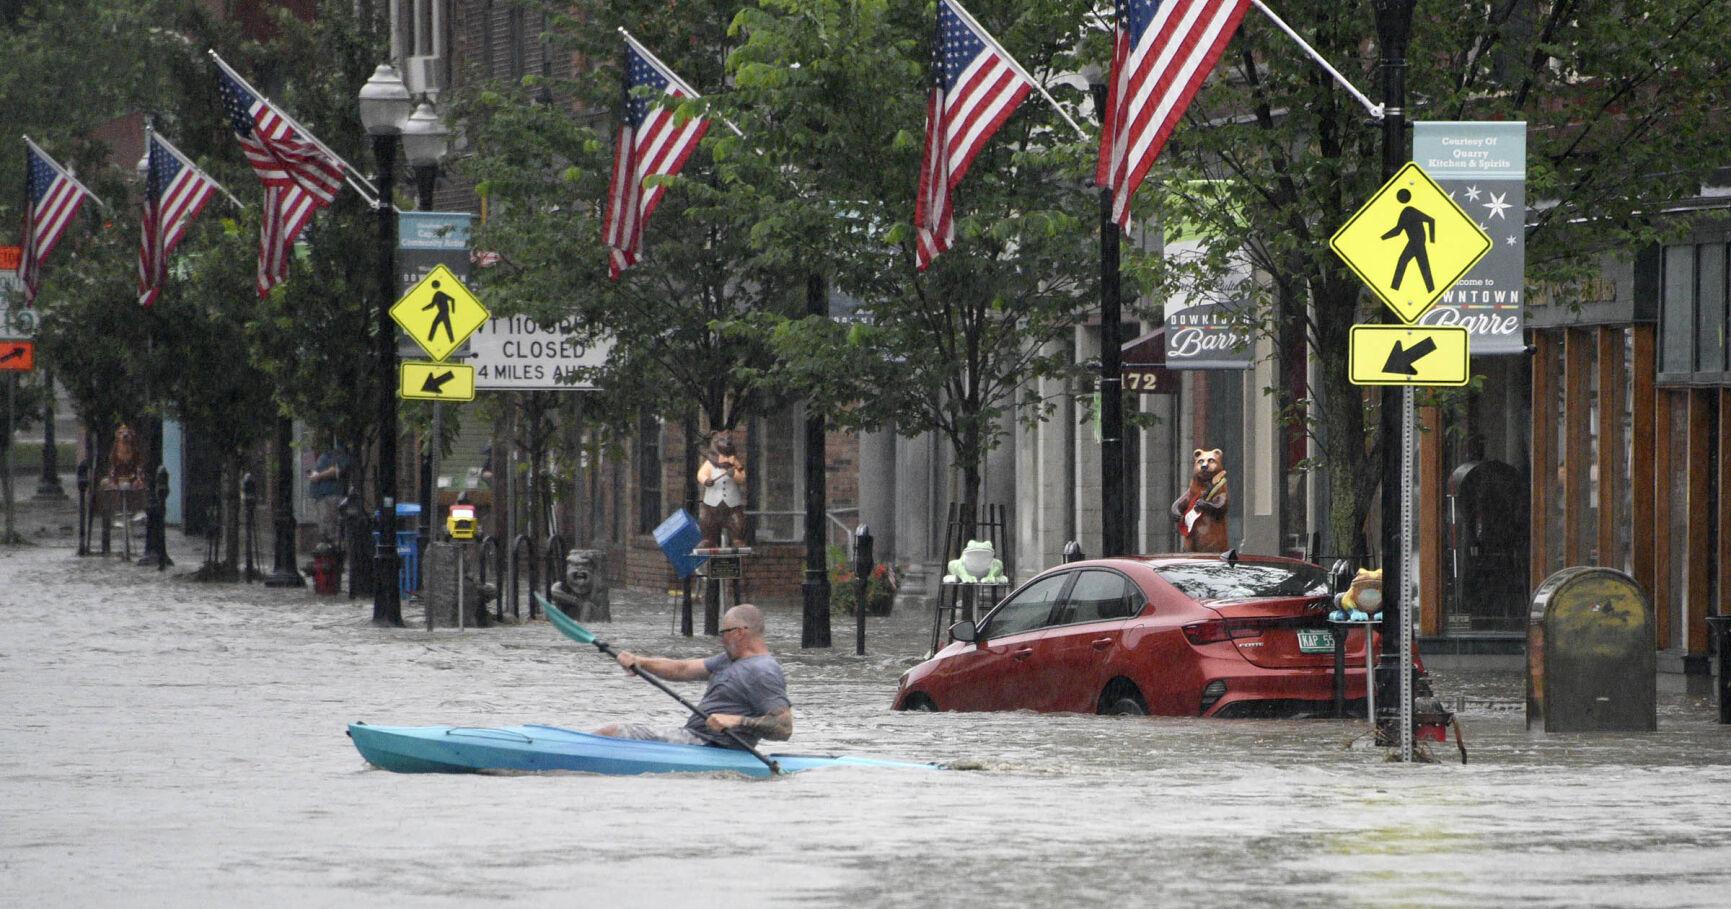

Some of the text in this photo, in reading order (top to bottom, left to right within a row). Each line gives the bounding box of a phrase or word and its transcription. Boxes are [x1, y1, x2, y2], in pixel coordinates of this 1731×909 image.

[1441, 136, 1498, 147] Courtesy Of
[1452, 148, 1489, 159] Quarry
[1428, 159, 1511, 170] Kitchen & Spirits
[1456, 278, 1495, 286] come to
[1442, 290, 1519, 303] WNTOWN
[509, 317, 537, 335] 110
[1170, 314, 1250, 325] DOWNTON
[1418, 307, 1520, 335] Barre
[502, 340, 586, 359] CLOSED
[477, 364, 489, 380] 4
[494, 364, 545, 380] MILES
[1302, 634, 1335, 647] KAP 55
